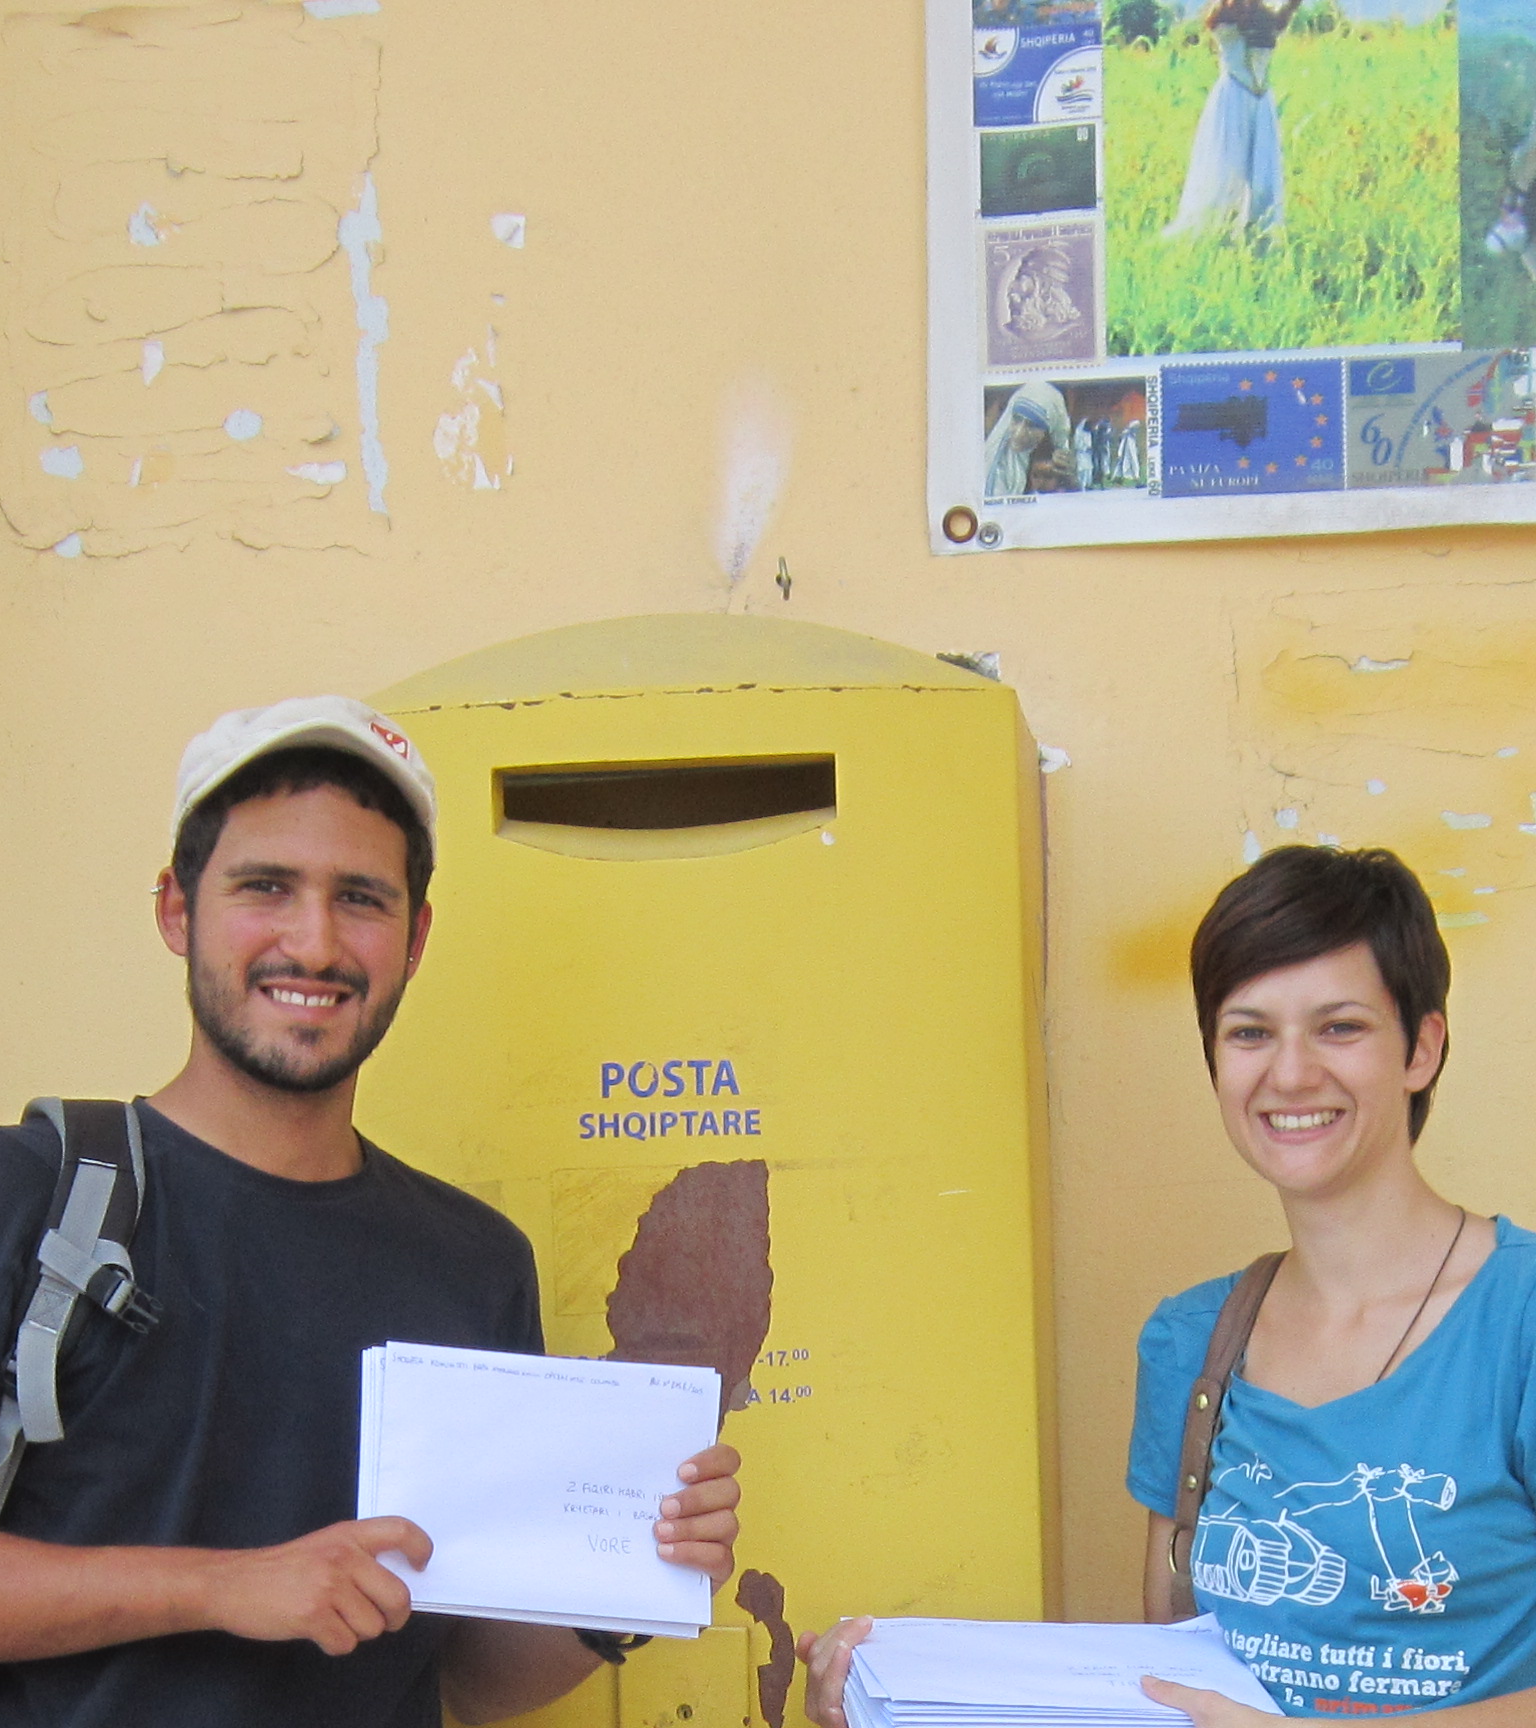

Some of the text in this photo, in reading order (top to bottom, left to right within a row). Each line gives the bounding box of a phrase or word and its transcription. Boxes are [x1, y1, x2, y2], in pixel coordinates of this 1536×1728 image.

[601, 1059, 740, 1098] POSTA
[579, 1109, 762, 1141] SHQIPTARE
[1231, 1628, 1313, 1662] tagliare
[1320, 1643, 1376, 1668] tutti
[1382, 1646, 1394, 1669] i
[1401, 1647, 1470, 1676] fiori,
[1285, 1687, 1304, 1708] la
[1347, 1670, 1463, 1697] fermare
